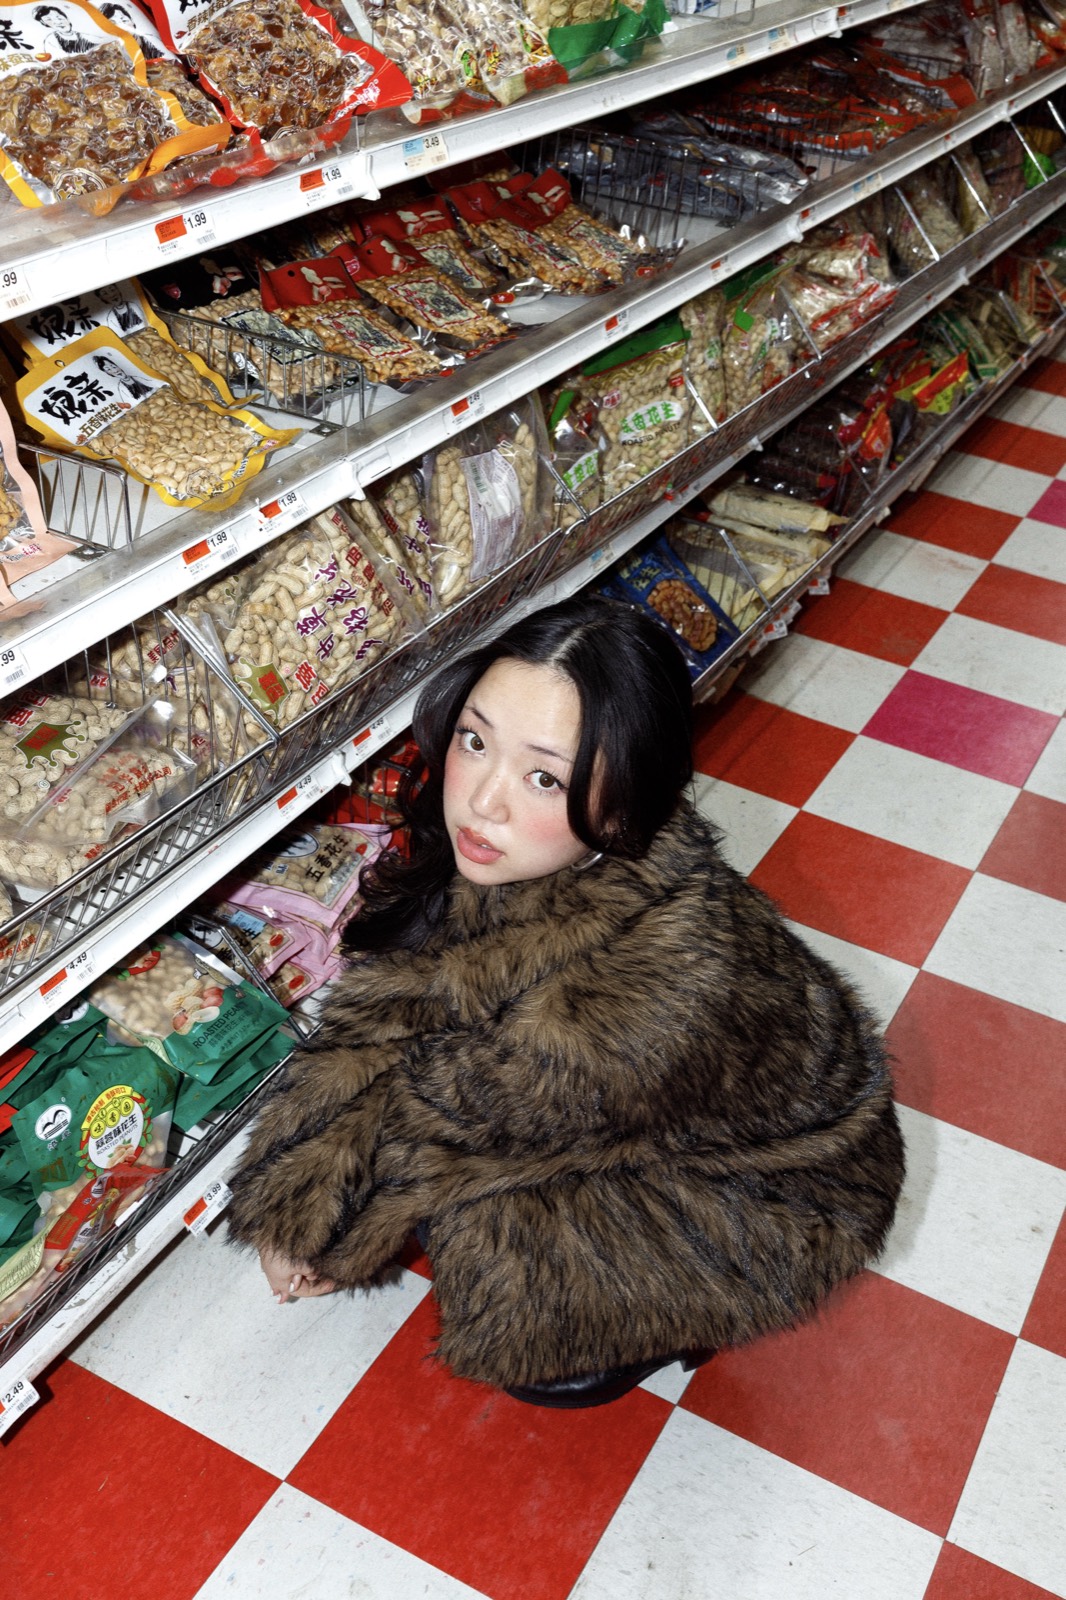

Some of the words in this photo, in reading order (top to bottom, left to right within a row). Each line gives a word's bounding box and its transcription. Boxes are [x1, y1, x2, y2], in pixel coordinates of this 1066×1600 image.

[38, 371, 115, 426] 娘亲
[79, 402, 122, 438] 五香味花生
[295, 606, 335, 660] 甘草
[305, 834, 350, 883] 五香花生
[192, 1018, 227, 1049] ROASTED
[97, 1138, 119, 1155] ROASTED
[118, 1124, 139, 1142] PEANUTS
